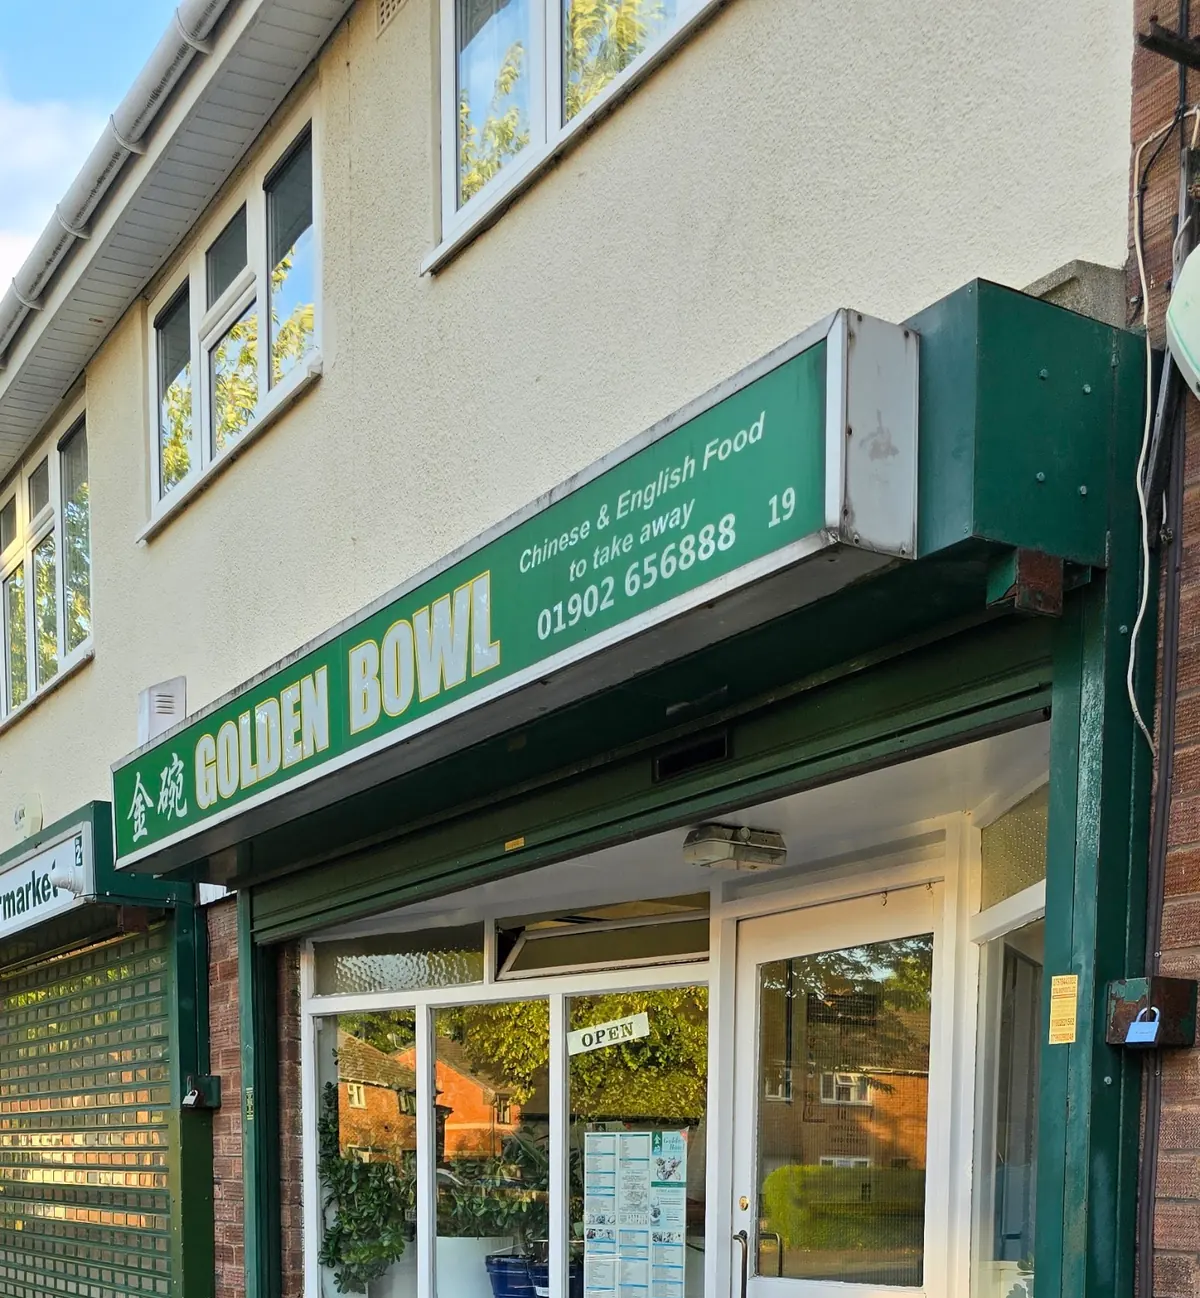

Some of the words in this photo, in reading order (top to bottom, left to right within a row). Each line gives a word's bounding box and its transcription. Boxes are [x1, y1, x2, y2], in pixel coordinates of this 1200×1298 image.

[519, 520, 591, 574] Chinese
[596, 503, 610, 530] &
[616, 455, 696, 520] English
[702, 410, 766, 471] Food
[767, 486, 796, 528] 19
[536, 575, 615, 641] 01902
[624, 513, 737, 597] 656888
[569, 558, 587, 582] to
[592, 535, 633, 570] take
[639, 498, 696, 541] away
[194, 665, 329, 810] GOLDEN
[348, 570, 501, 736] BOWL
[126, 751, 188, 843] 金碗
[581, 1020, 634, 1048] OPEN
